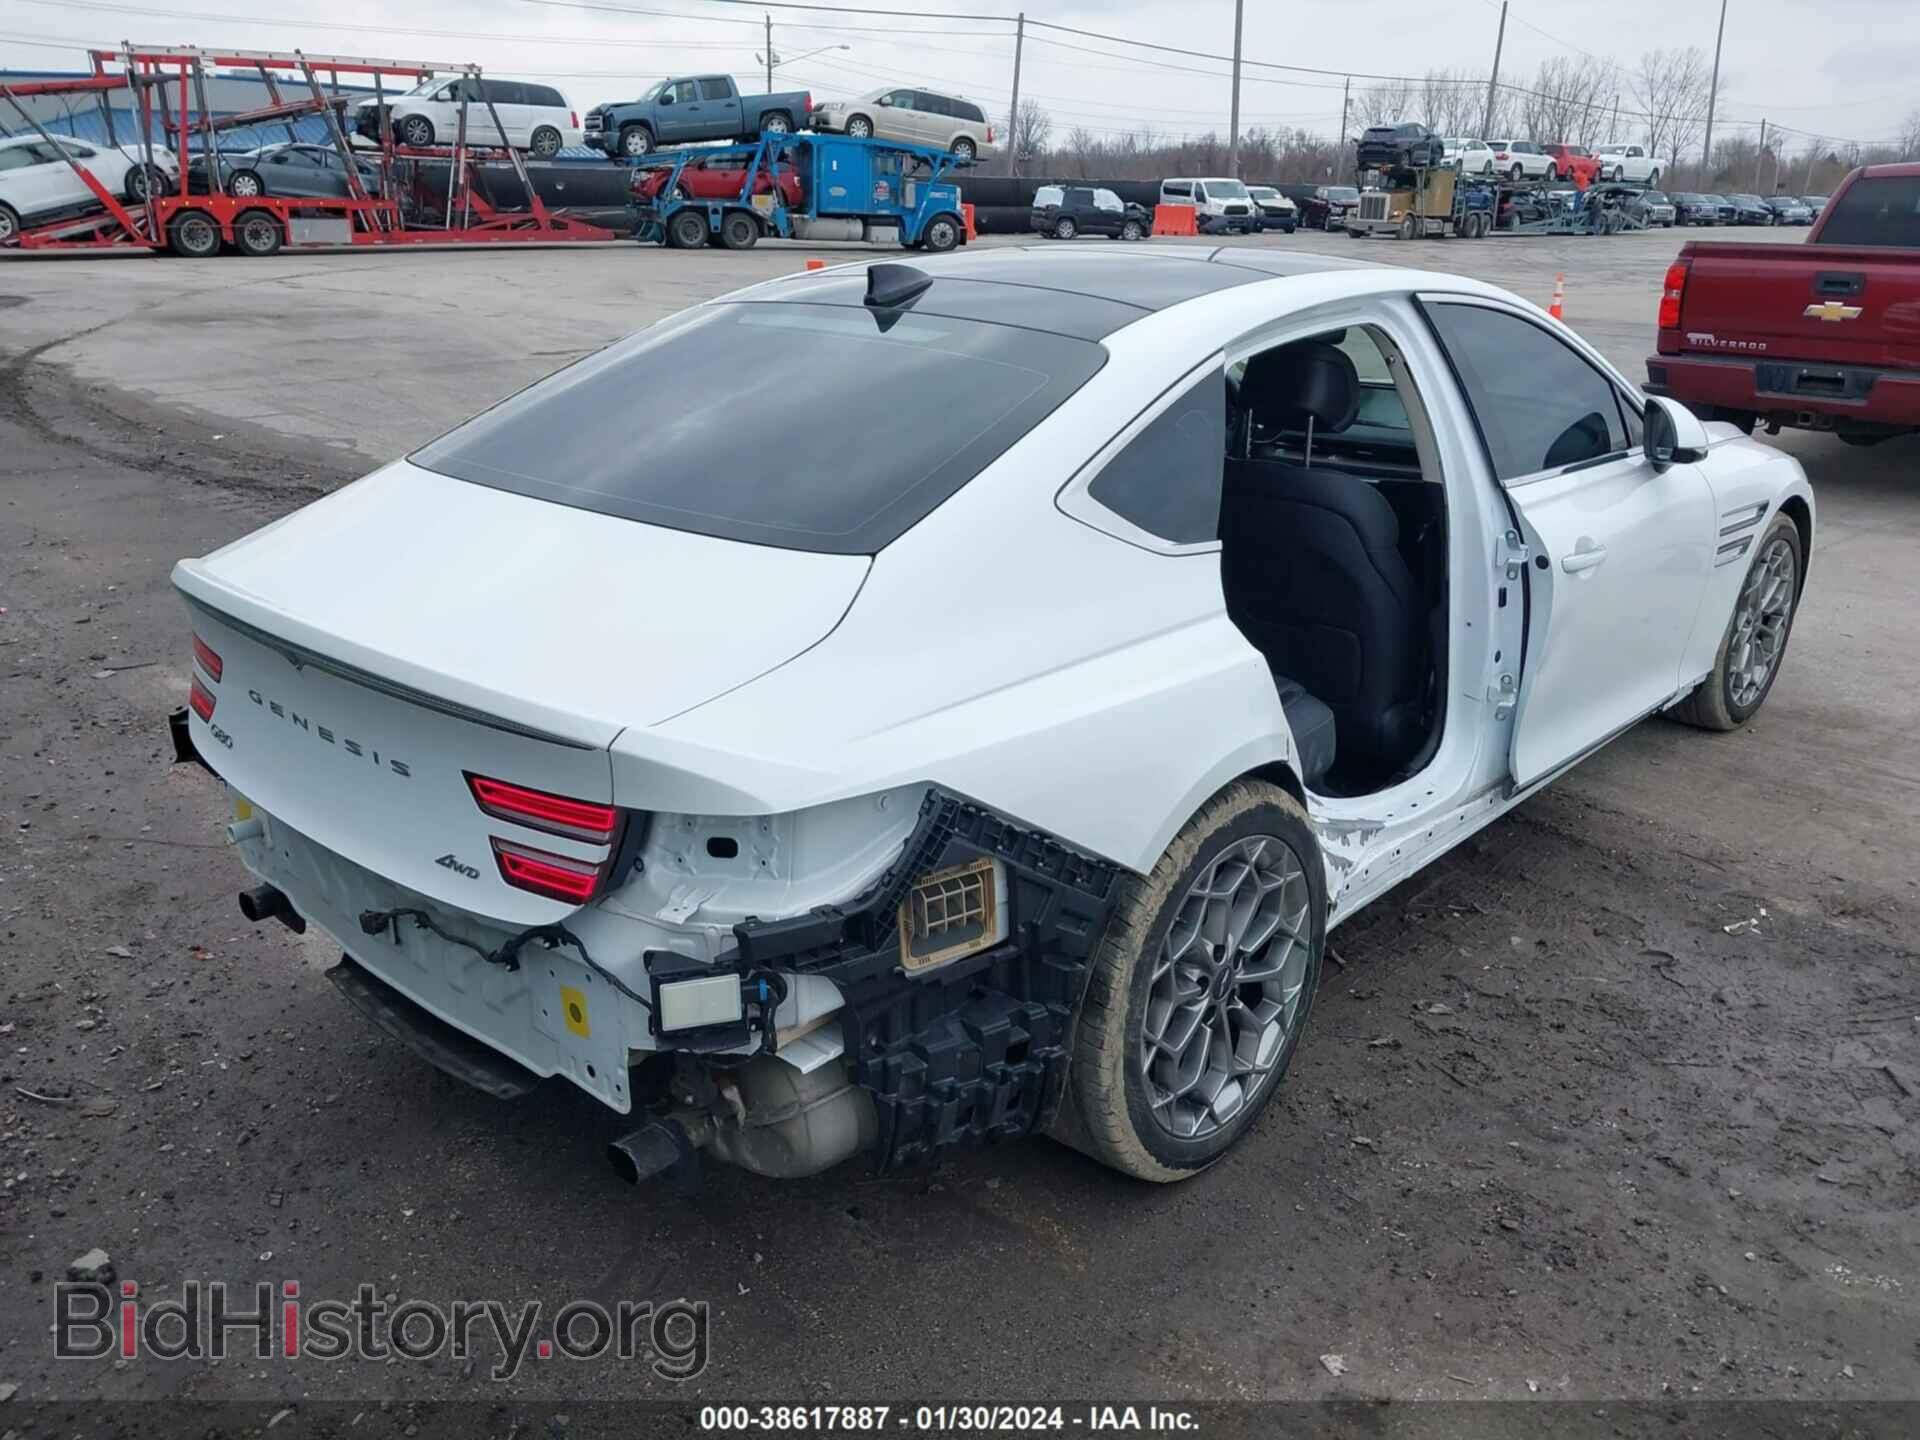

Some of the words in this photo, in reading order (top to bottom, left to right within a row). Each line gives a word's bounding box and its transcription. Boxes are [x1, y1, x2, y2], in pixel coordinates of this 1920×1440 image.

[210, 723, 234, 750] G80
[248, 689, 411, 777] GENESIS
[434, 854, 480, 880] 4WD
